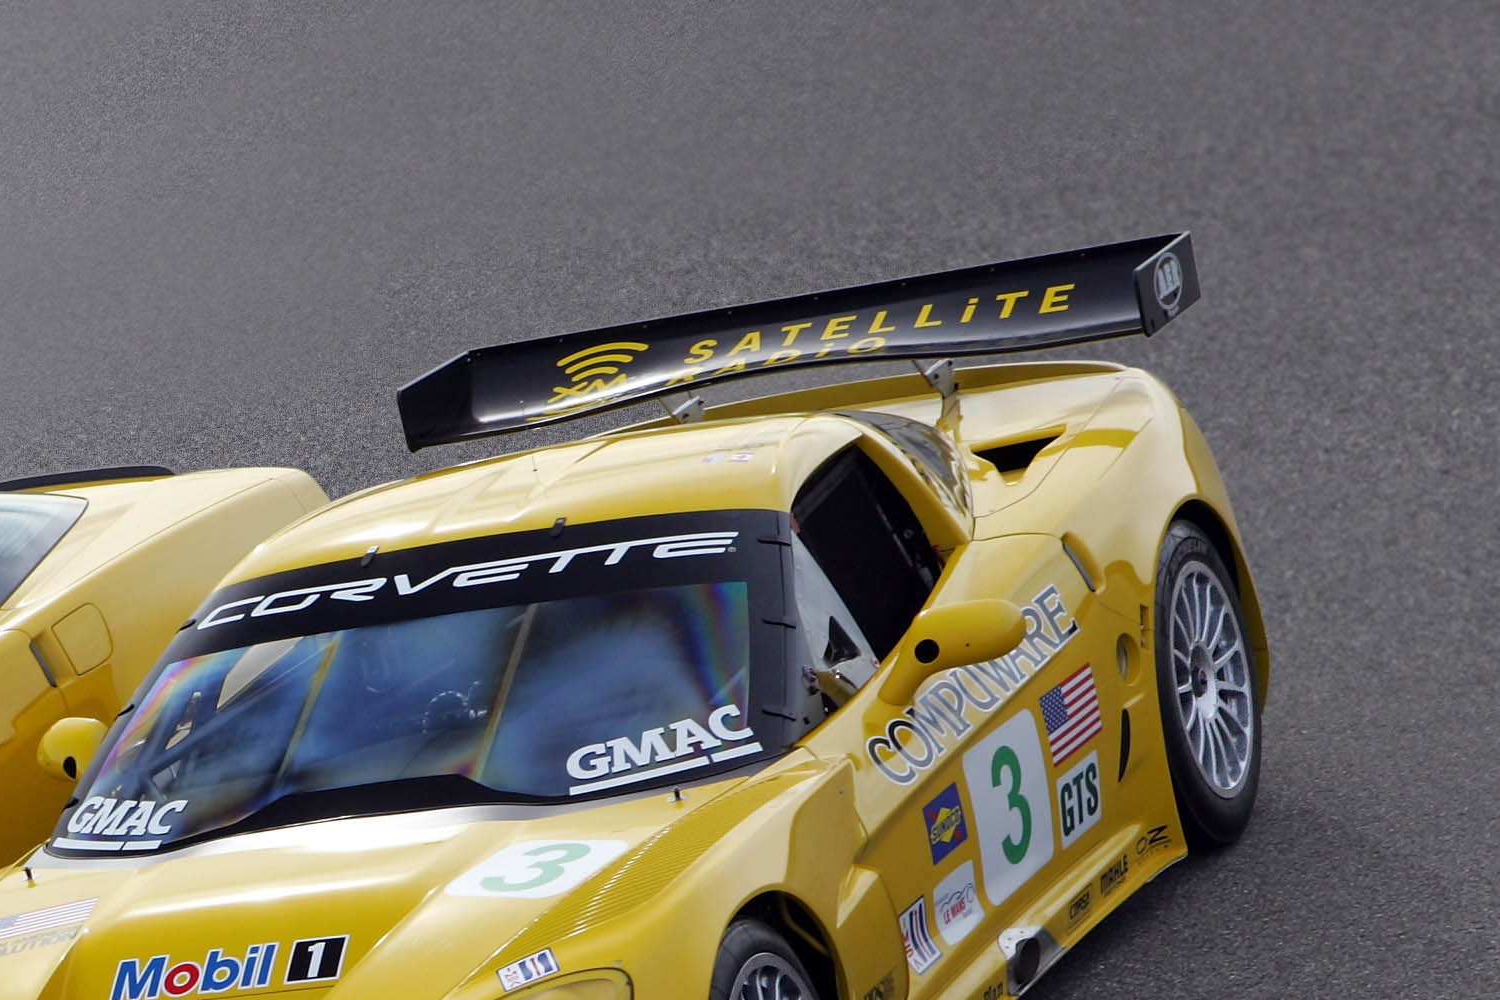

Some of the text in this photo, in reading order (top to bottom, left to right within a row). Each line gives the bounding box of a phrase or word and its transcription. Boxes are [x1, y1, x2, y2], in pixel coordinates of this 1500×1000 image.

[197, 531, 739, 629] CORVETTE
[567, 703, 756, 780] GMAC
[67, 798, 188, 837] GMAC
[991, 745, 1032, 865] 3
[1060, 762, 1099, 837] GTS
[480, 842, 590, 893] 3
